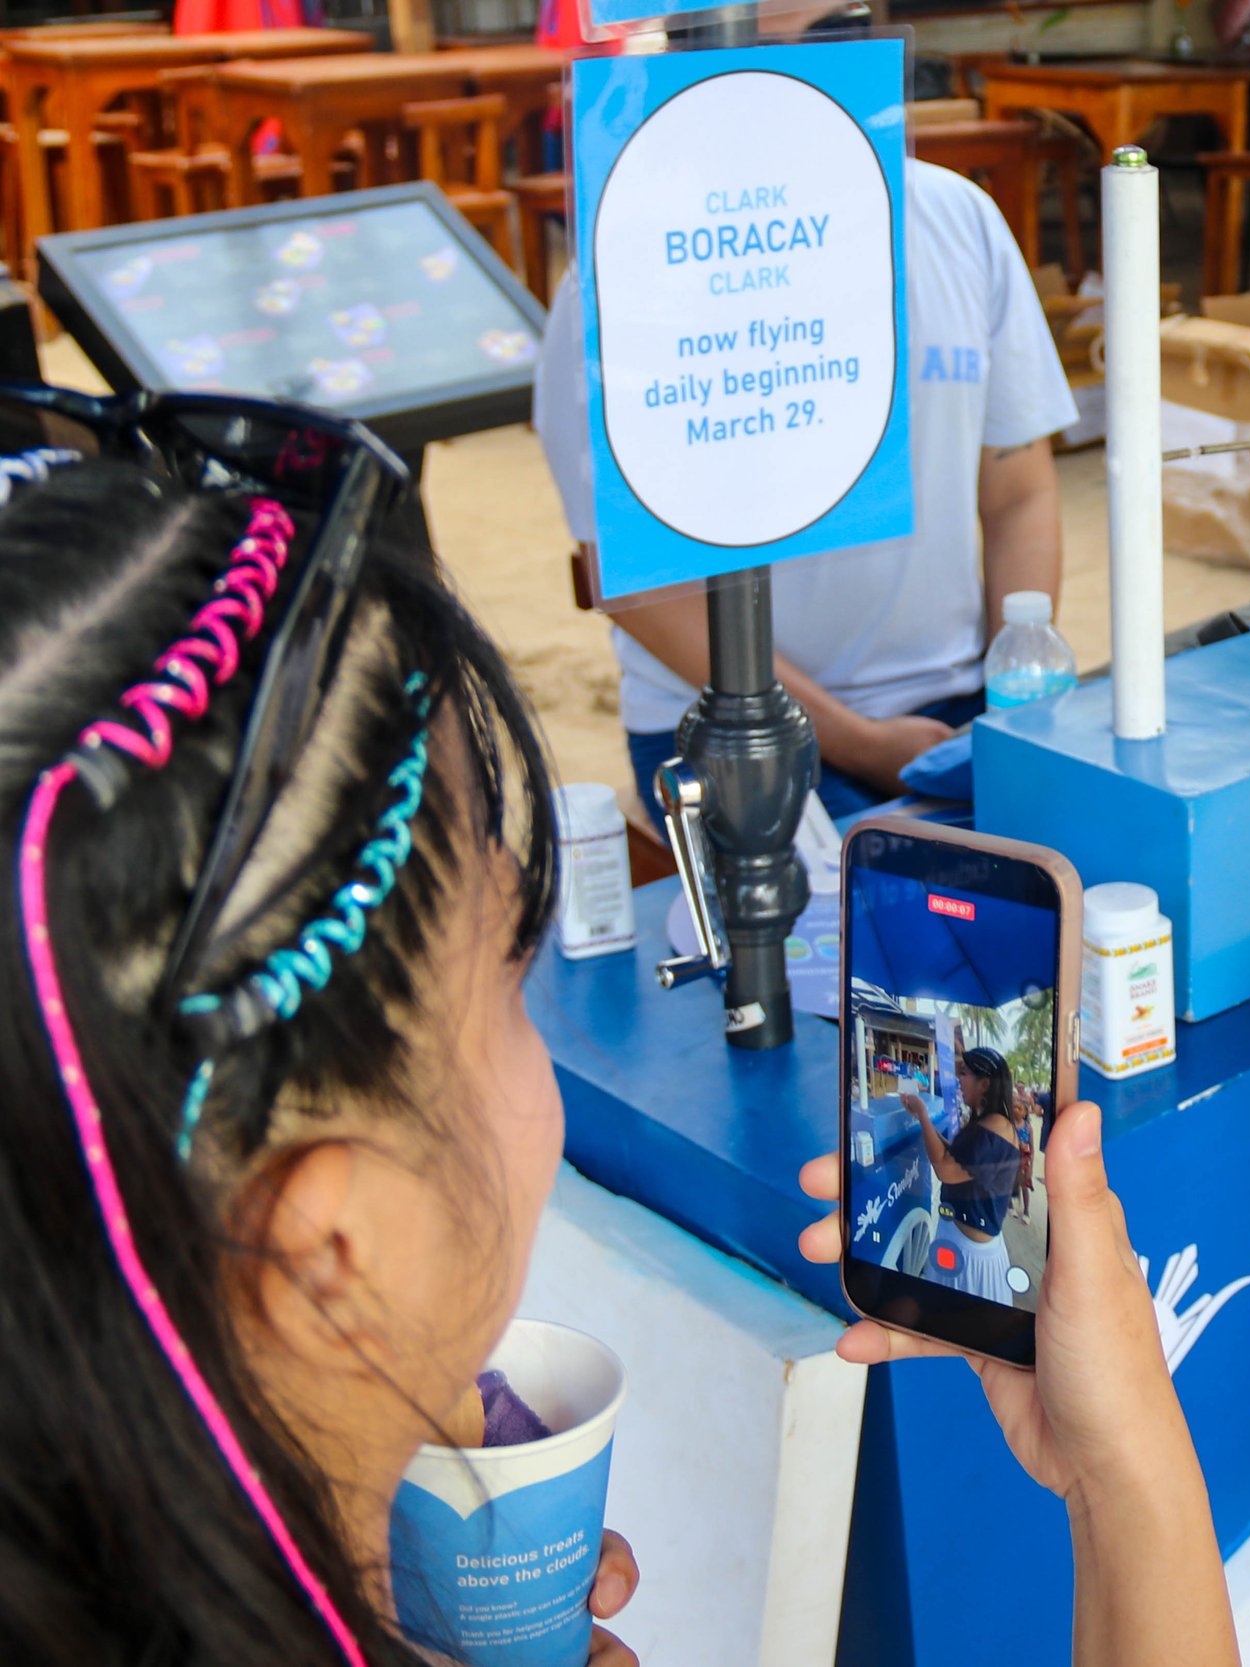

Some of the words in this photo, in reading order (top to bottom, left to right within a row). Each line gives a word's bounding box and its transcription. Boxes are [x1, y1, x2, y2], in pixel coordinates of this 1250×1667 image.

[705, 184, 788, 215] CLARK
[665, 214, 830, 265] BORACAY
[709, 264, 791, 296] CLARK
[678, 329, 739, 358] now
[748, 315, 825, 352] flying
[644, 373, 713, 409] daily
[723, 354, 860, 397] beginning
[686, 406, 775, 446] March
[785, 399, 825, 429] 29.
[932, 898, 972, 917] 00:00:07
[456, 1550, 539, 1569] Delicious
[543, 1530, 585, 1557] treats
[457, 1574, 509, 1588] above
[515, 1567, 542, 1583] the
